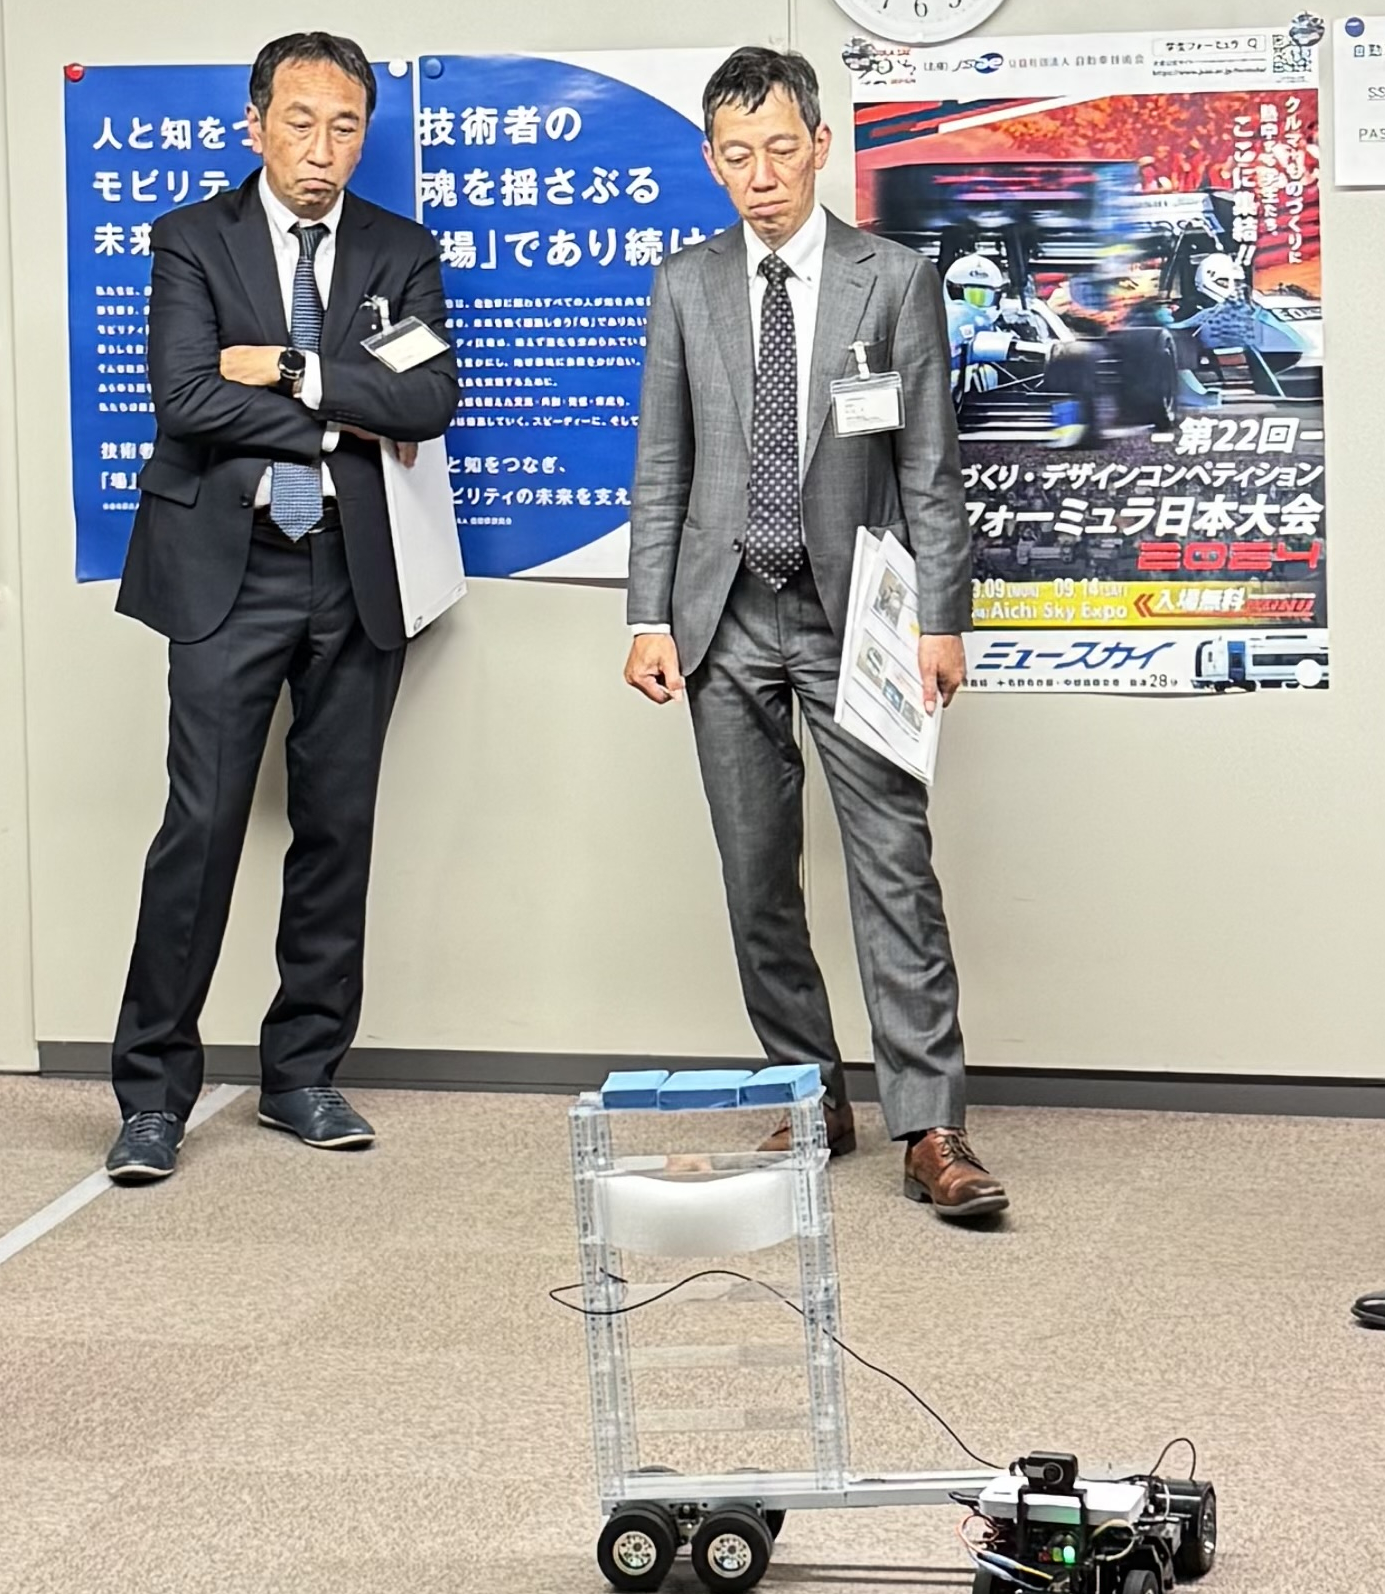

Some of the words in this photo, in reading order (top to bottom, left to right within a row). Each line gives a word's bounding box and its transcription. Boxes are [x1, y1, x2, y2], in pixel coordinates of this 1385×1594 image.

[418, 106, 582, 147] 技術者の
[421, 166, 660, 208] 魂を揺さぶる
[961, 460, 1325, 491] づくり・デザインコンペティション
[1137, 542, 1323, 572] 2024
[991, 602, 1037, 620] Aichi
[1043, 602, 1075, 621] Sky
[1081, 602, 1128, 620] Expo
[1154, 587, 1245, 612] 入場無料
[974, 642, 1177, 670] ミュースカイ
